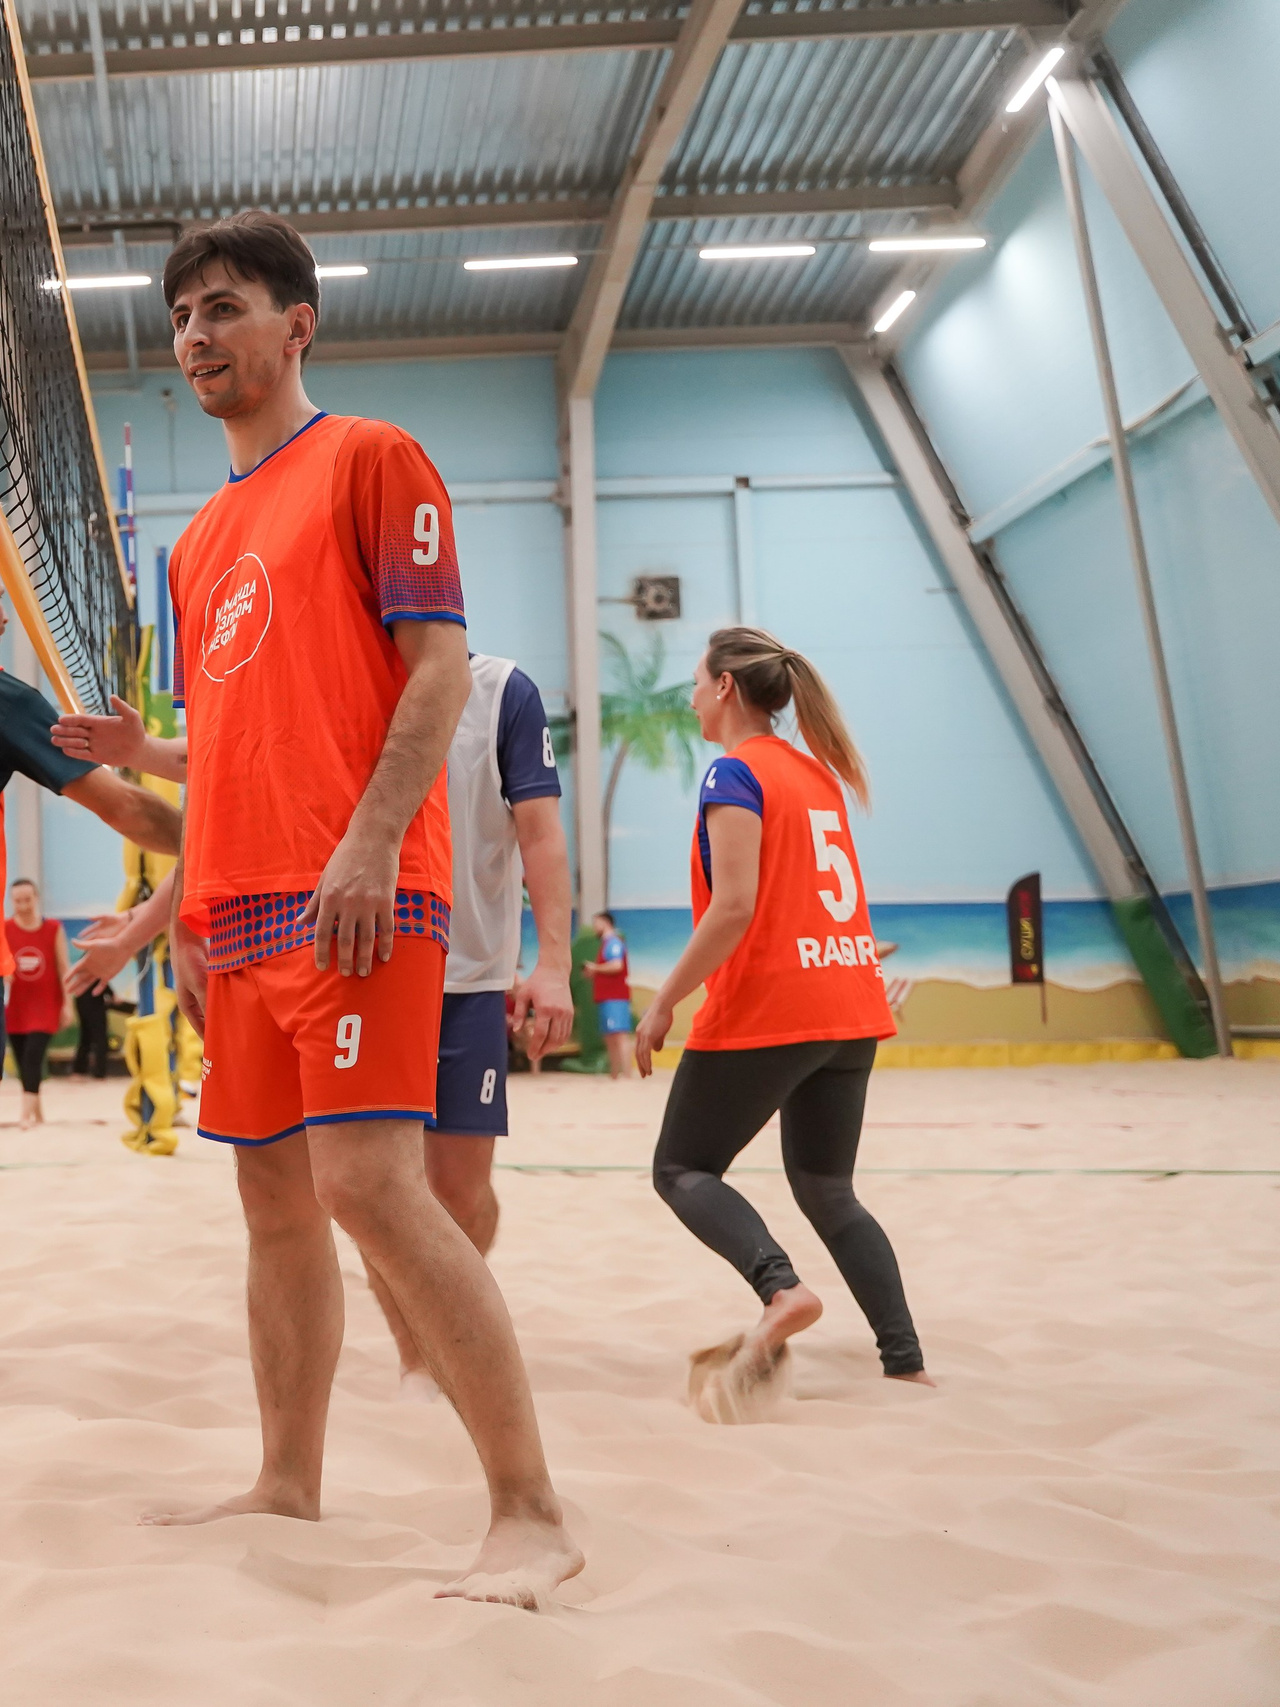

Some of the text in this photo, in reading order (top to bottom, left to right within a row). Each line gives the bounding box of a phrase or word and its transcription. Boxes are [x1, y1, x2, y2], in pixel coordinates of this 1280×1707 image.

[413, 503, 440, 565] 9
[543, 727, 556, 768] 8
[808, 808, 858, 923] 5
[334, 1014, 362, 1069] 9
[479, 1068, 497, 1104] 8
